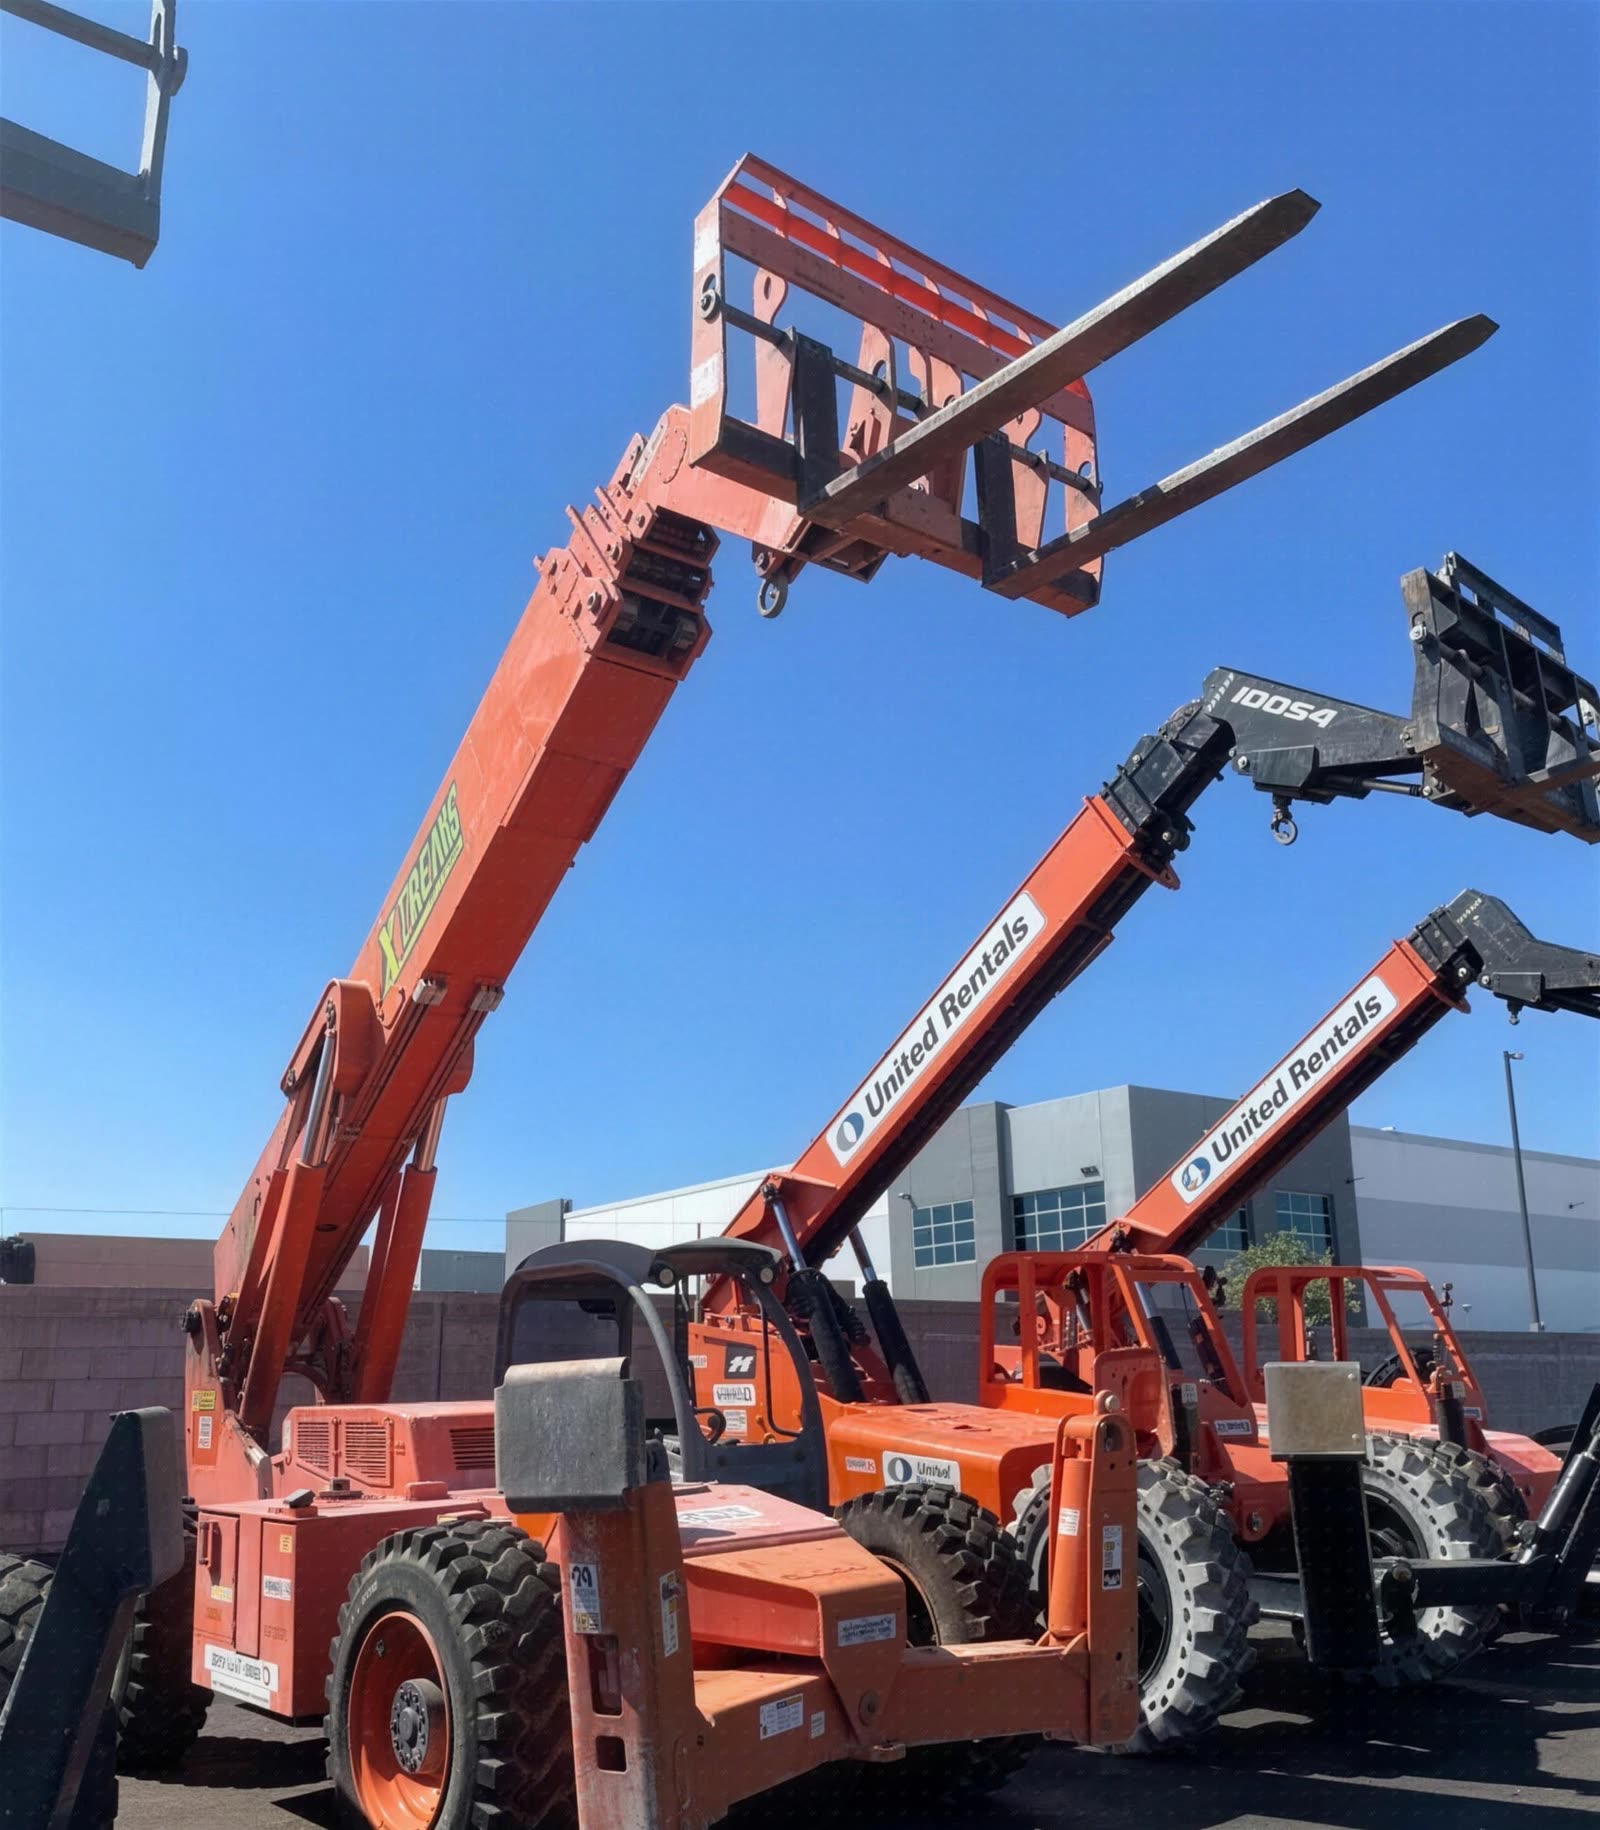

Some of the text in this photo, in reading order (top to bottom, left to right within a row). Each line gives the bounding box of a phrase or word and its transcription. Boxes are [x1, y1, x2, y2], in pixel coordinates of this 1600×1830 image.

[865, 915, 1029, 1117] United Rentals
[1211, 996, 1382, 1162] United Rentals
